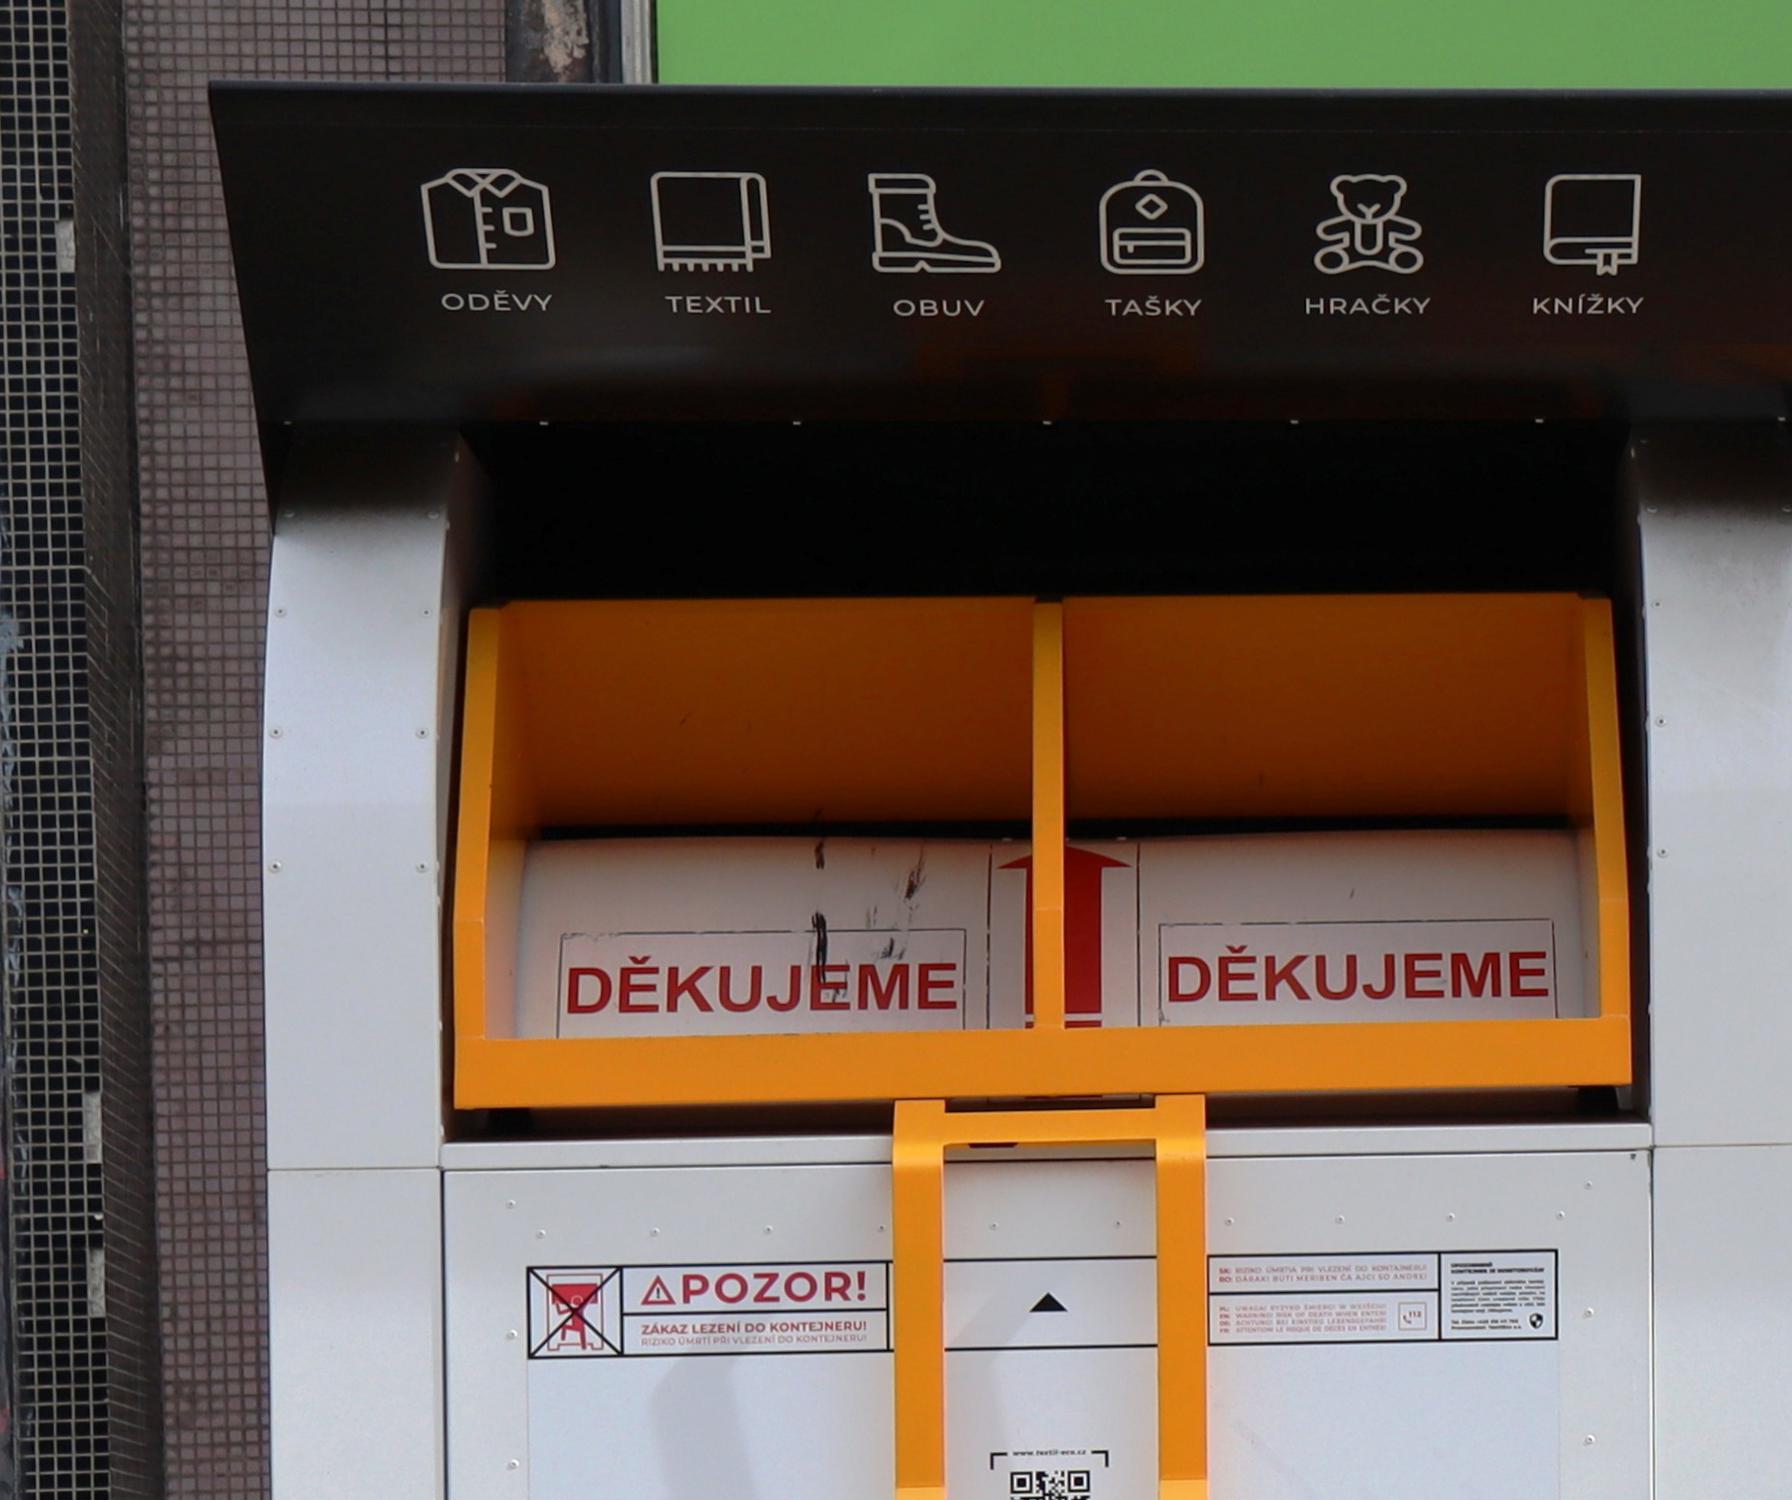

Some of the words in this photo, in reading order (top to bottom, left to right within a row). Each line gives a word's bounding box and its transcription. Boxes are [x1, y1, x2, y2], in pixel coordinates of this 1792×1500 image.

[440, 290, 552, 312] ODĚVY
[665, 295, 771, 315] TEXTIL
[893, 299, 984, 318] OBUV
[1105, 296, 1202, 317] TAŠKY
[1305, 294, 1431, 315] HRAČKY
[1533, 293, 1644, 315] KNÍŽKY
[1167, 945, 1549, 1003] DĚKUJEME
[567, 956, 957, 1014] DĚKUJEME
[682, 1271, 867, 1305] POZOR!
[641, 1322, 689, 1336] ZÁKAZ
[692, 1320, 741, 1334] LEZENÍ
[744, 1322, 766, 1333] DO
[770, 1320, 867, 1333] KONTEJNERU!
[777, 1335, 794, 1344] DO
